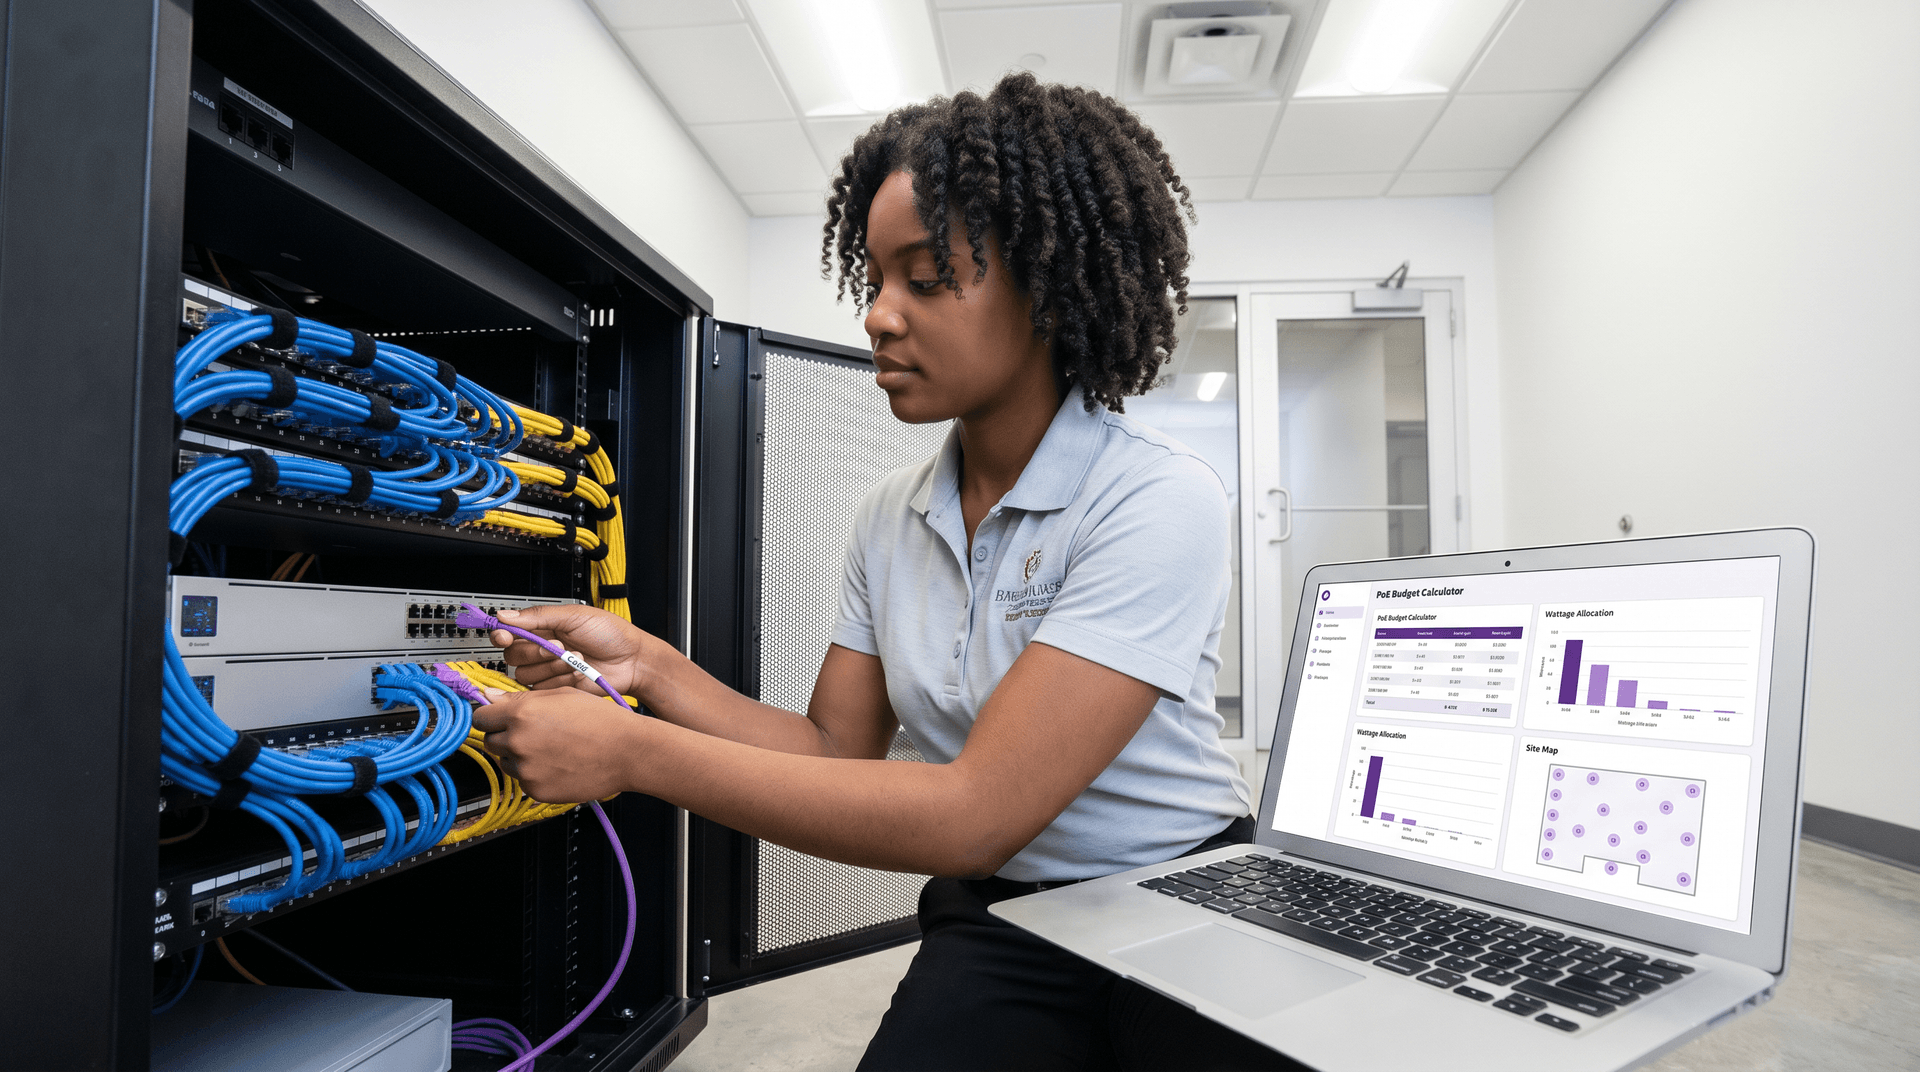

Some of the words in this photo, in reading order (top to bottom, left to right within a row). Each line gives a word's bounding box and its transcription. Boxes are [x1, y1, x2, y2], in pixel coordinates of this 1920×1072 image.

[1376, 590, 1391, 599] PoE
[1392, 588, 1420, 598] Budget
[1421, 587, 1464, 597] Calculator
[1377, 614, 1387, 622] PoE
[1388, 614, 1407, 622] Budget
[1408, 613, 1437, 621] Calculator
[1545, 610, 1575, 618] Wattage
[1576, 609, 1614, 618] Allocation
[1379, 731, 1406, 739] Allocation
[1526, 744, 1540, 753] Site
[1541, 745, 1558, 755] Map
